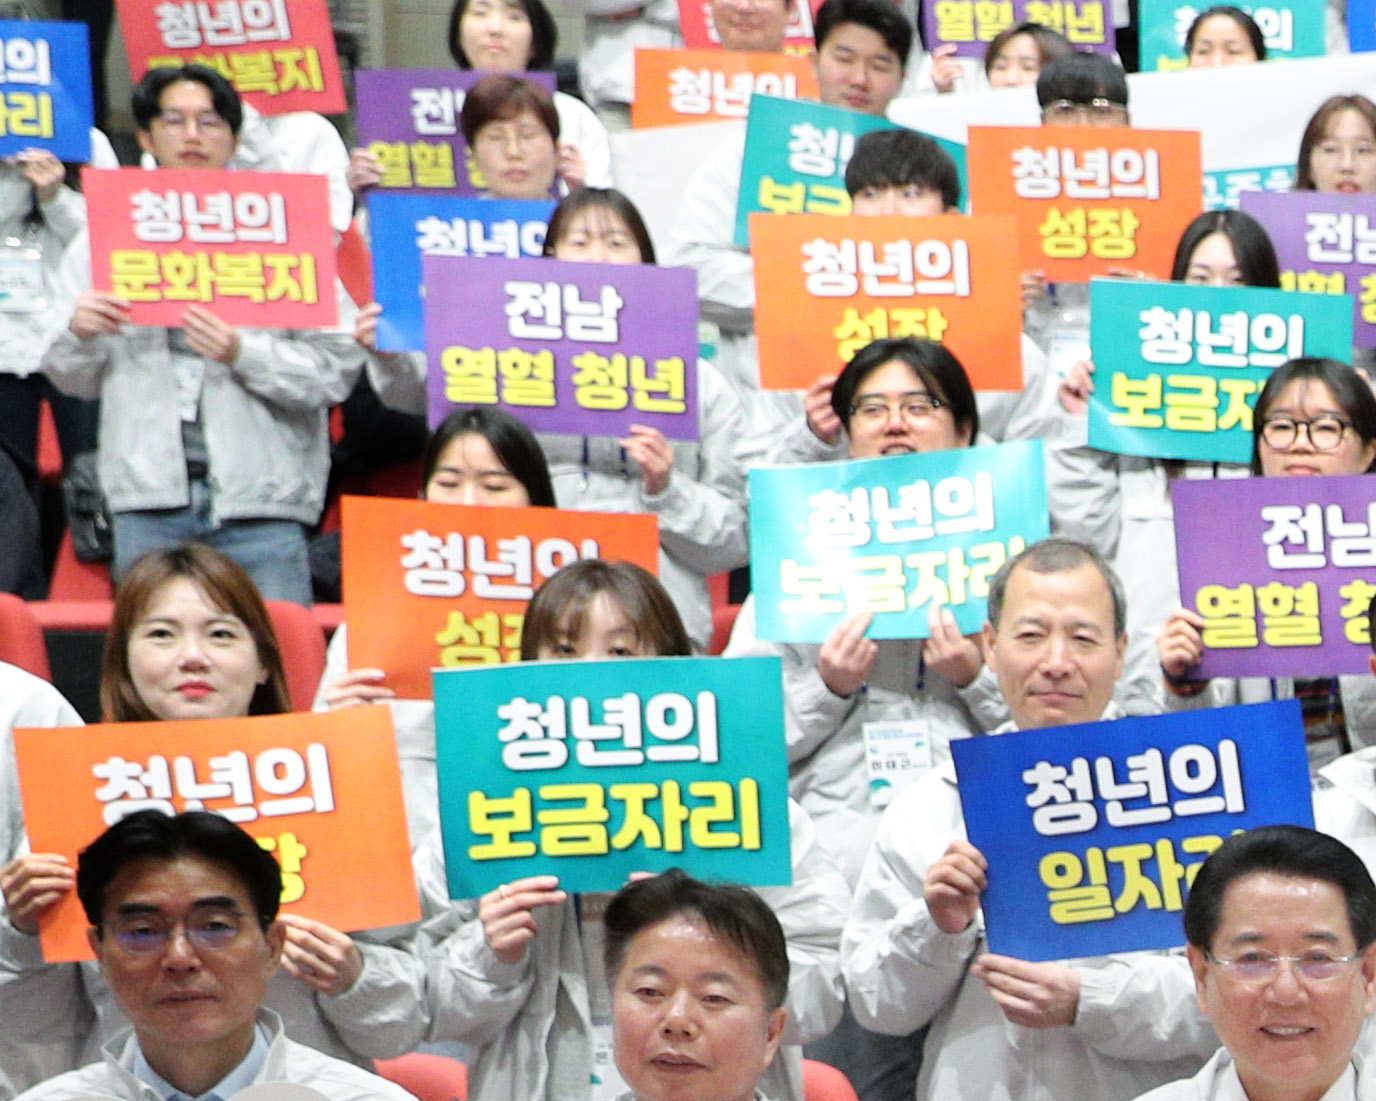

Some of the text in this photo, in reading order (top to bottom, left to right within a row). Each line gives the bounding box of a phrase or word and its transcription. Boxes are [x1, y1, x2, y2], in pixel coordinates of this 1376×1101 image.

[155, 0, 292, 48] 청년의
[410, 87, 466, 134] 전
[1011, 147, 1160, 200] 청년의
[131, 189, 288, 244] 청년의
[1040, 208, 1139, 259] 성장
[111, 249, 317, 303] 문화복지
[802, 239, 970, 296] 청년의
[503, 281, 623, 342] 전남
[1139, 306, 1304, 368] 청년의
[441, 346, 687, 413] 열혈 청년
[1109, 371, 1263, 432] 보금자
[807, 472, 994, 547] 청년의
[435, 611, 525, 667] 성
[1197, 580, 1322, 648] 열혈
[498, 691, 719, 771] 청년의
[93, 742, 334, 826] 청년의
[1023, 739, 1244, 836] 청년의
[468, 778, 760, 860] 보금자리
